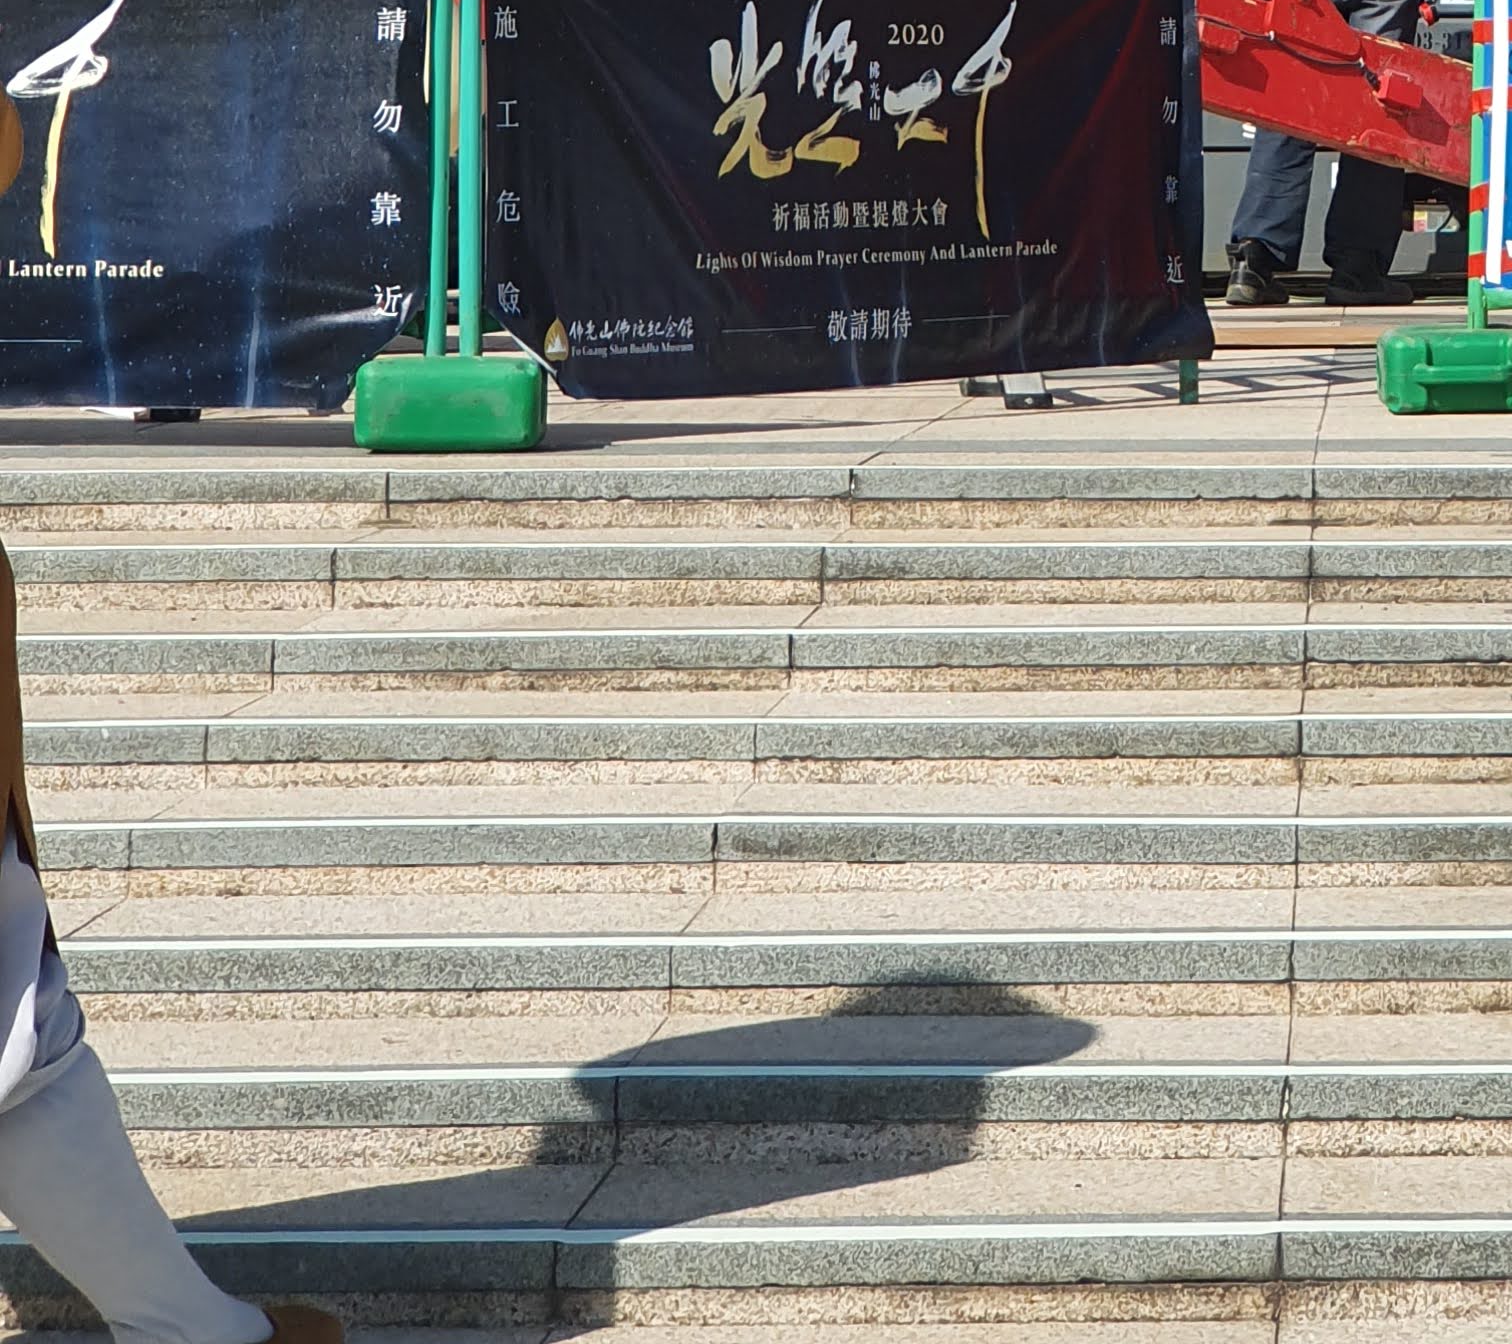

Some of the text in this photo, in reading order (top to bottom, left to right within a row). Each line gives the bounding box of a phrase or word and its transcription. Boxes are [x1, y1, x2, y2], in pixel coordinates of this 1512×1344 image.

[887, 23, 945, 46] 2020
[868, 60, 881, 121] 佛光山
[370, 6, 408, 317] 請勿靠近
[1160, 16, 1185, 284] 請勿靠近
[771, 197, 949, 232] 祈福活動暨提燈大會
[8, 259, 165, 278] Lantern Parade
[695, 239, 1058, 275] Lights Of Wisdom Prayer Ceremony And Lantern Parade
[826, 306, 913, 342] 敬請期待
